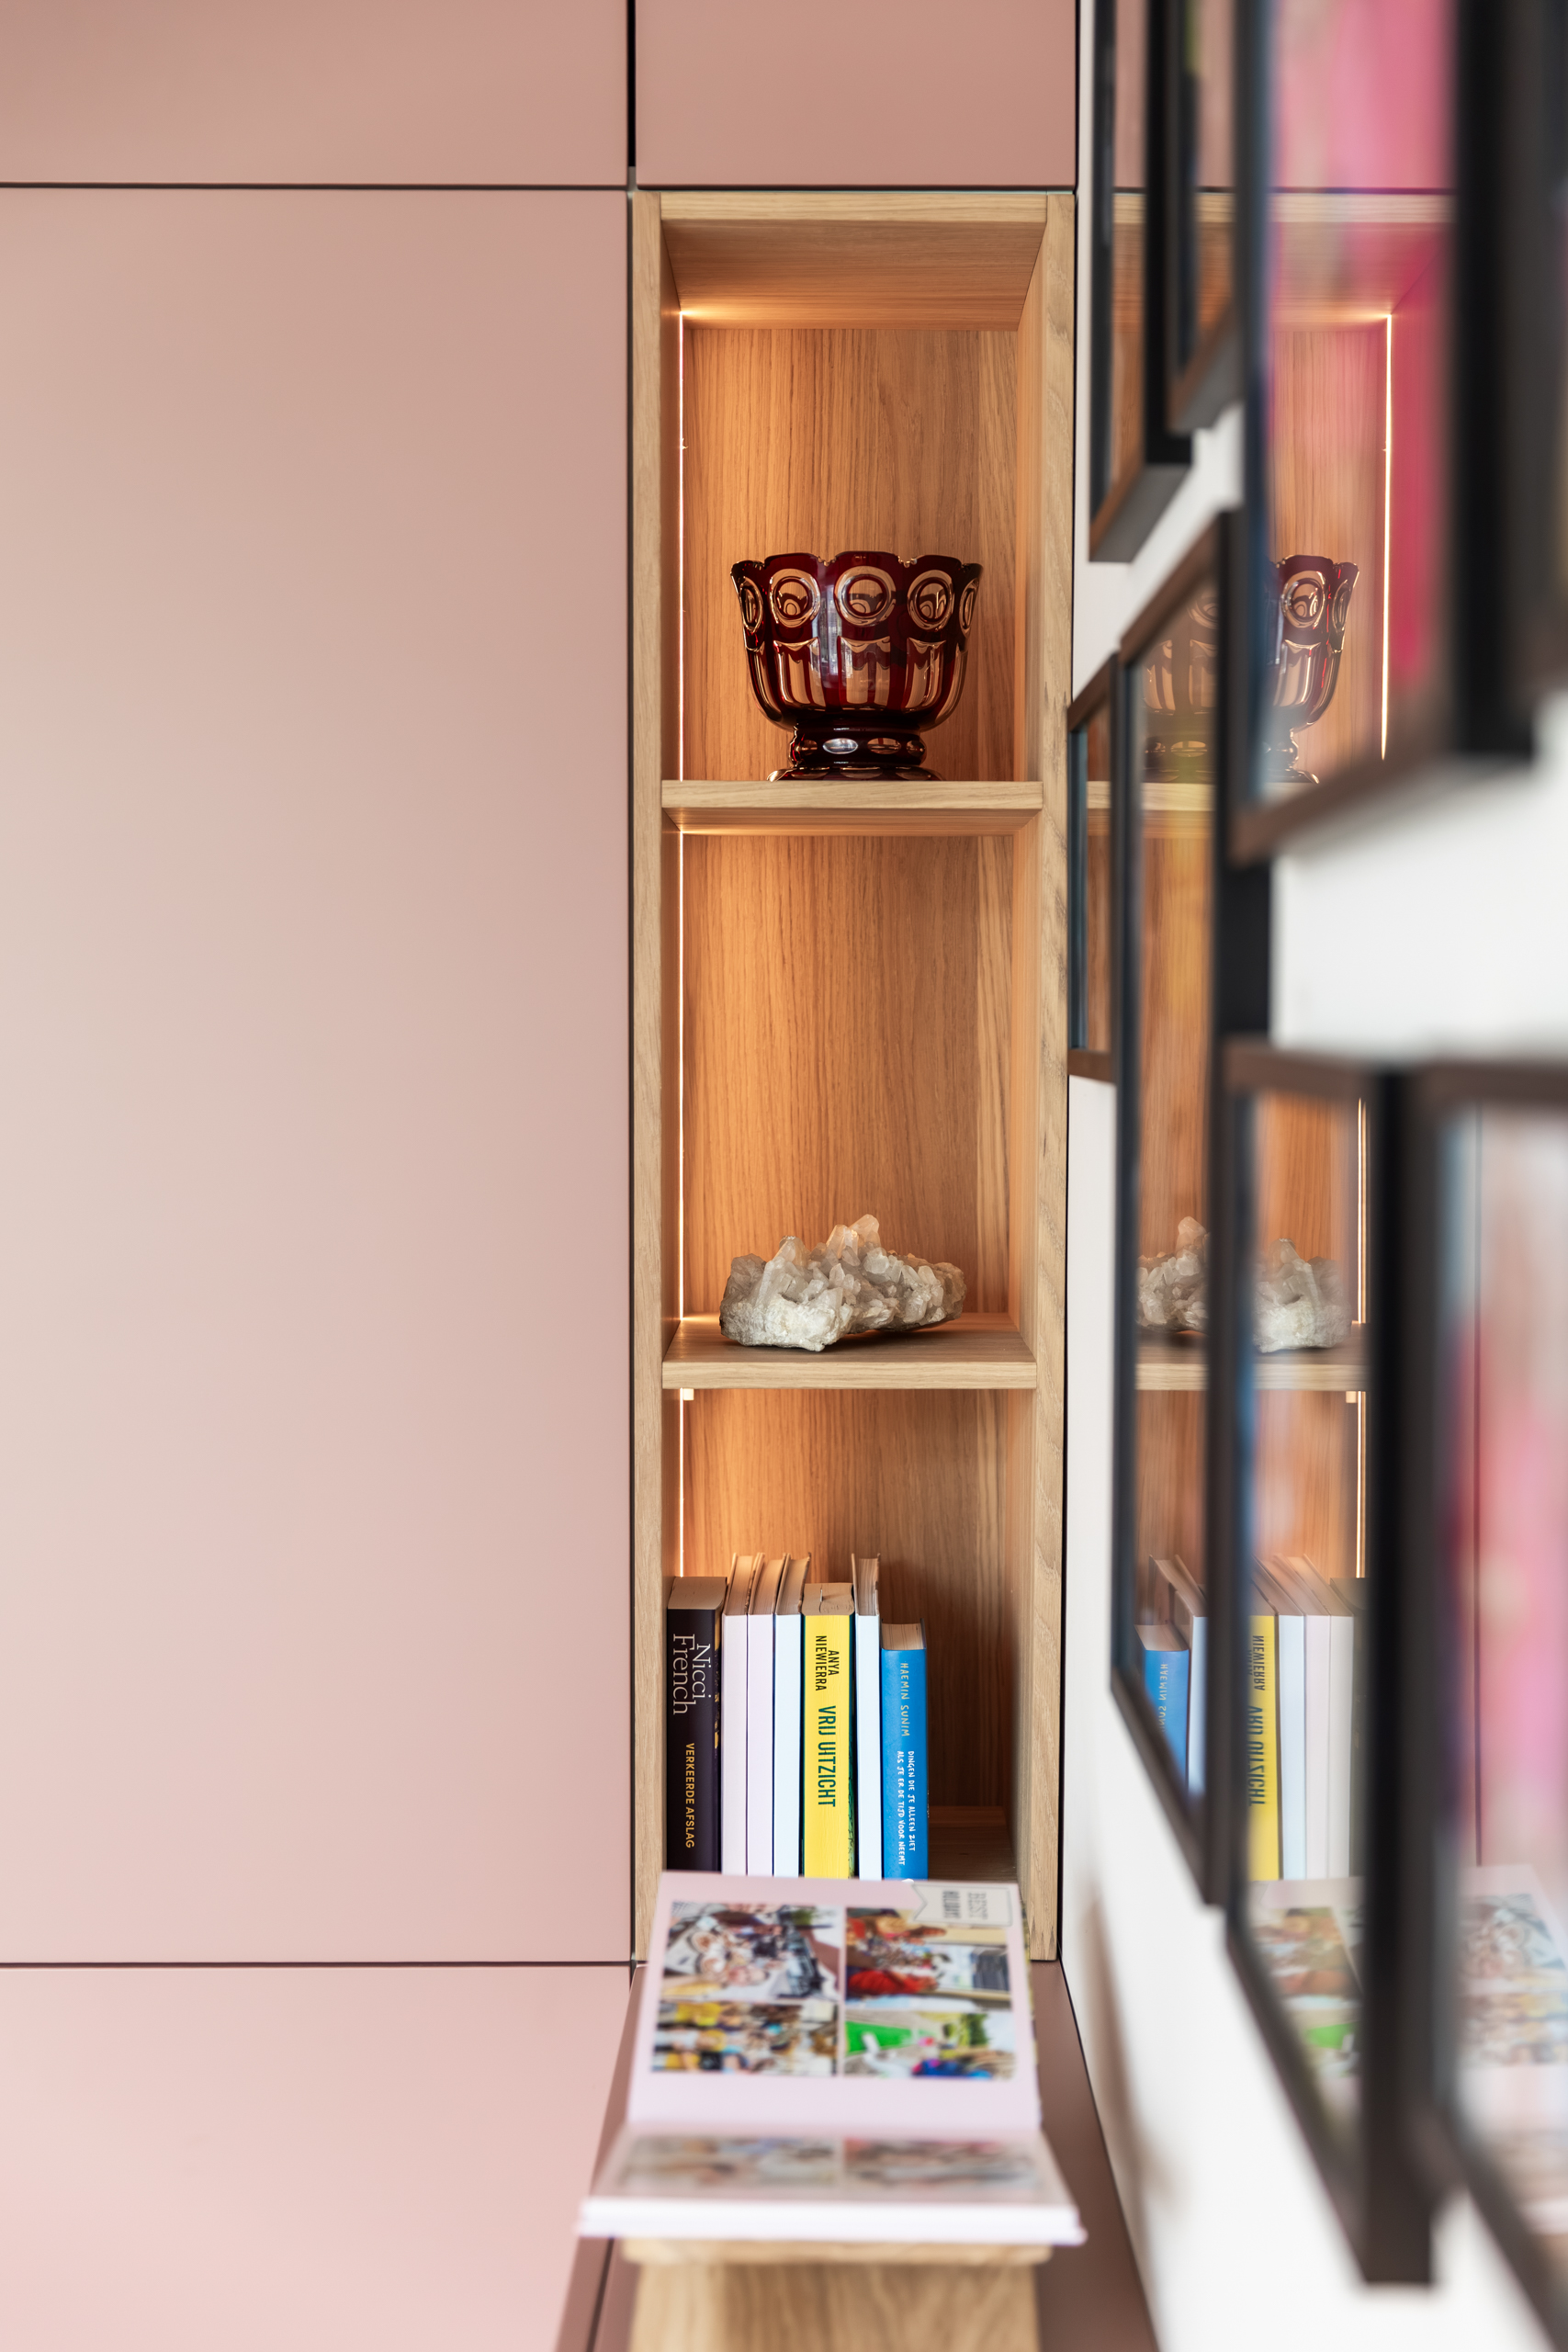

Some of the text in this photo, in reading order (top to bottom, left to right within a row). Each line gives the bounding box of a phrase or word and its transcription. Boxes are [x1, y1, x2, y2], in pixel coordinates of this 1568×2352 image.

[672, 1634, 696, 1715] French
[692, 1643, 712, 1700] Nicci
[815, 1635, 827, 1691] NIEWIERRA
[828, 1649, 840, 1676] ANYA
[900, 1662, 910, 1736] HAEMIN SUNIM
[818, 1705, 837, 1807] VRIJ UITZICHT
[685, 1743, 695, 1849] VERKEERDE AFSLAG
[897, 1750, 906, 1866] ALS JE ER DE TIJD VOOR NEEMT
[908, 1780, 916, 1792] DIE
[908, 1793, 916, 1804] JE
[908, 1805, 916, 1832] ALLEEN
